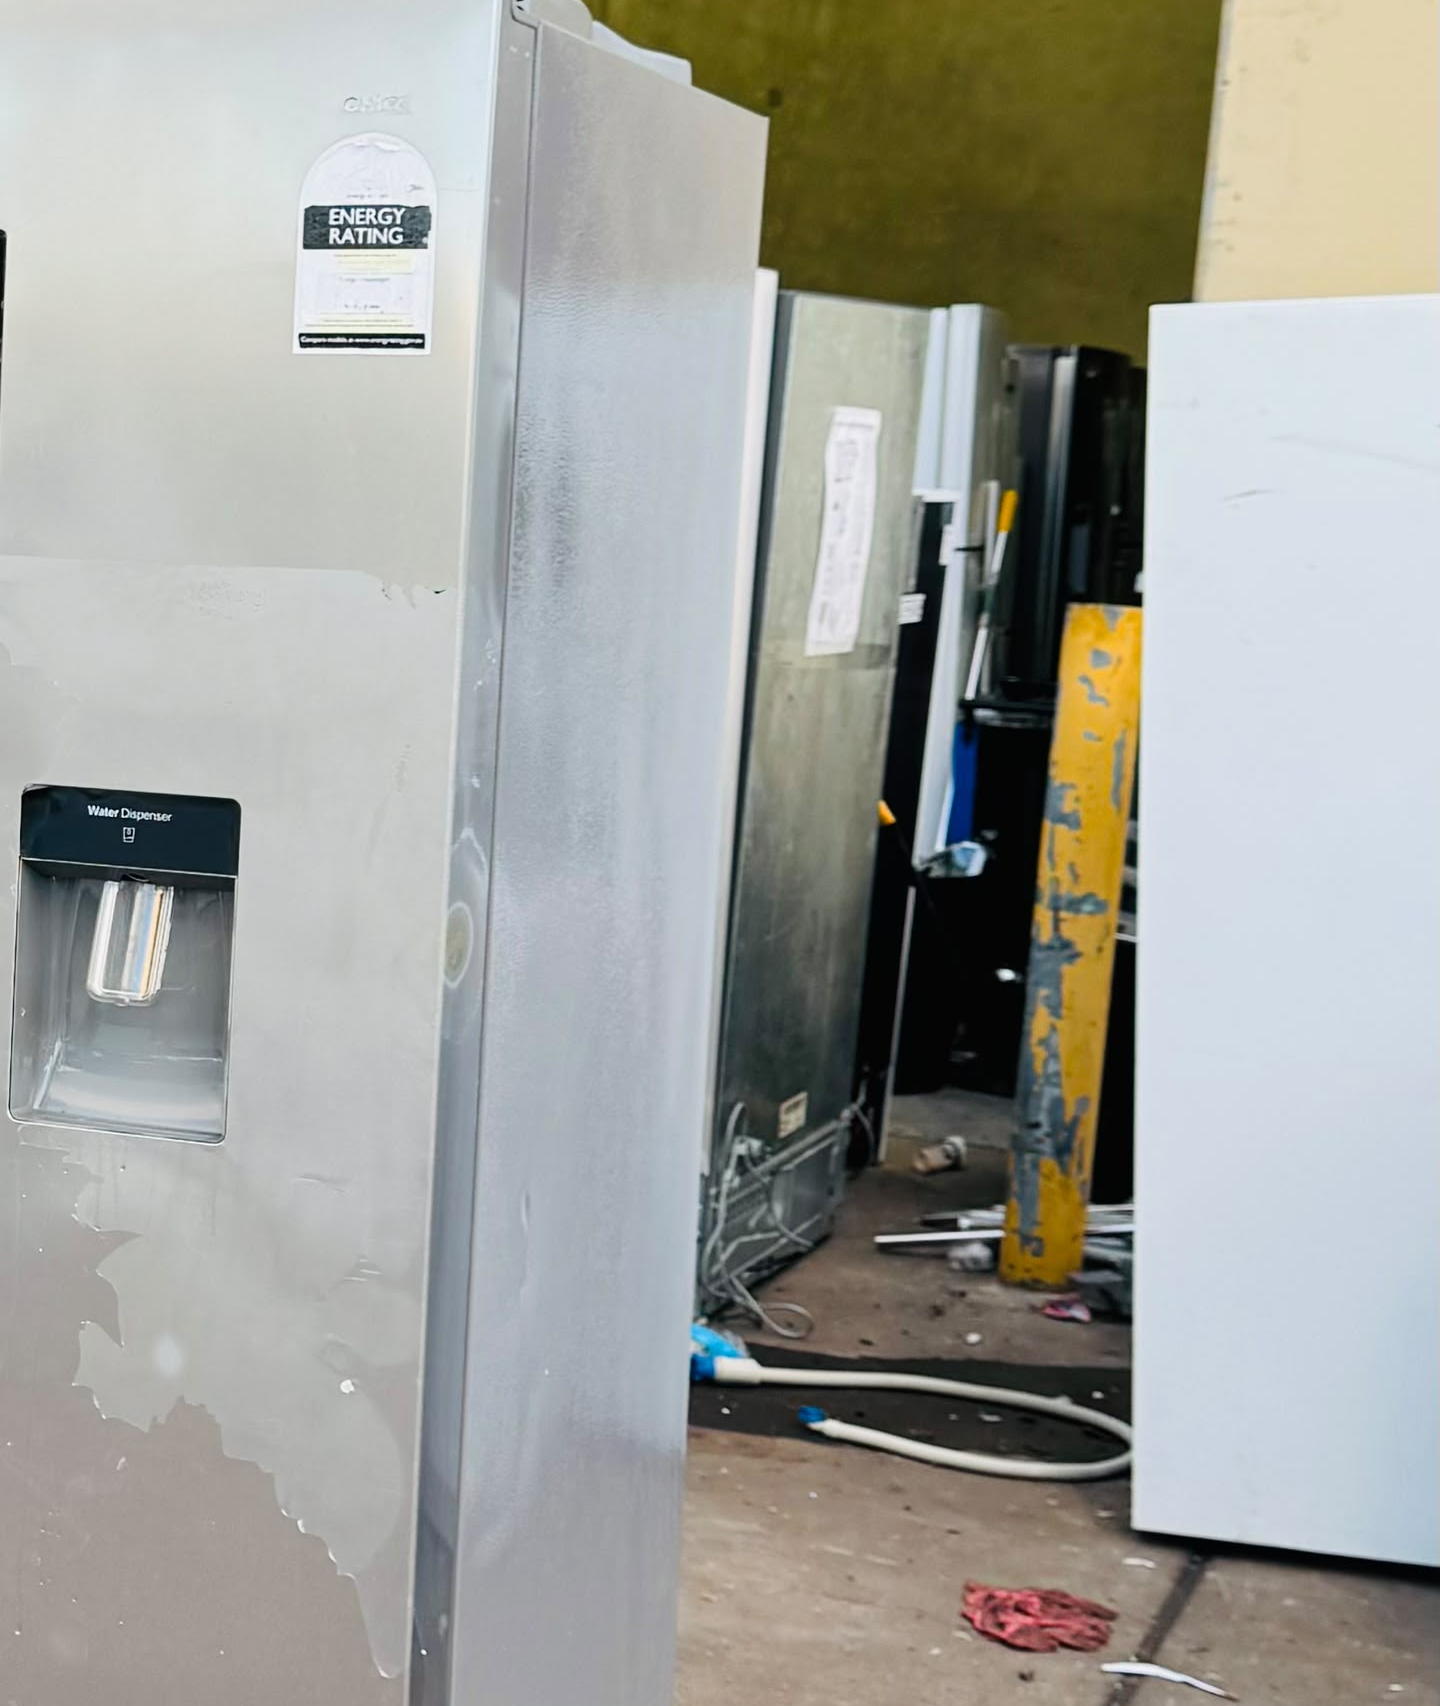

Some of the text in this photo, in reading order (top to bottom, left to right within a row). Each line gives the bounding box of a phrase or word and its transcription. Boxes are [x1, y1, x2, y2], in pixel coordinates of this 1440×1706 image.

[328, 207, 406, 225] ENERGY
[328, 226, 404, 245] RATING
[87, 804, 173, 822] Water Dispenser
